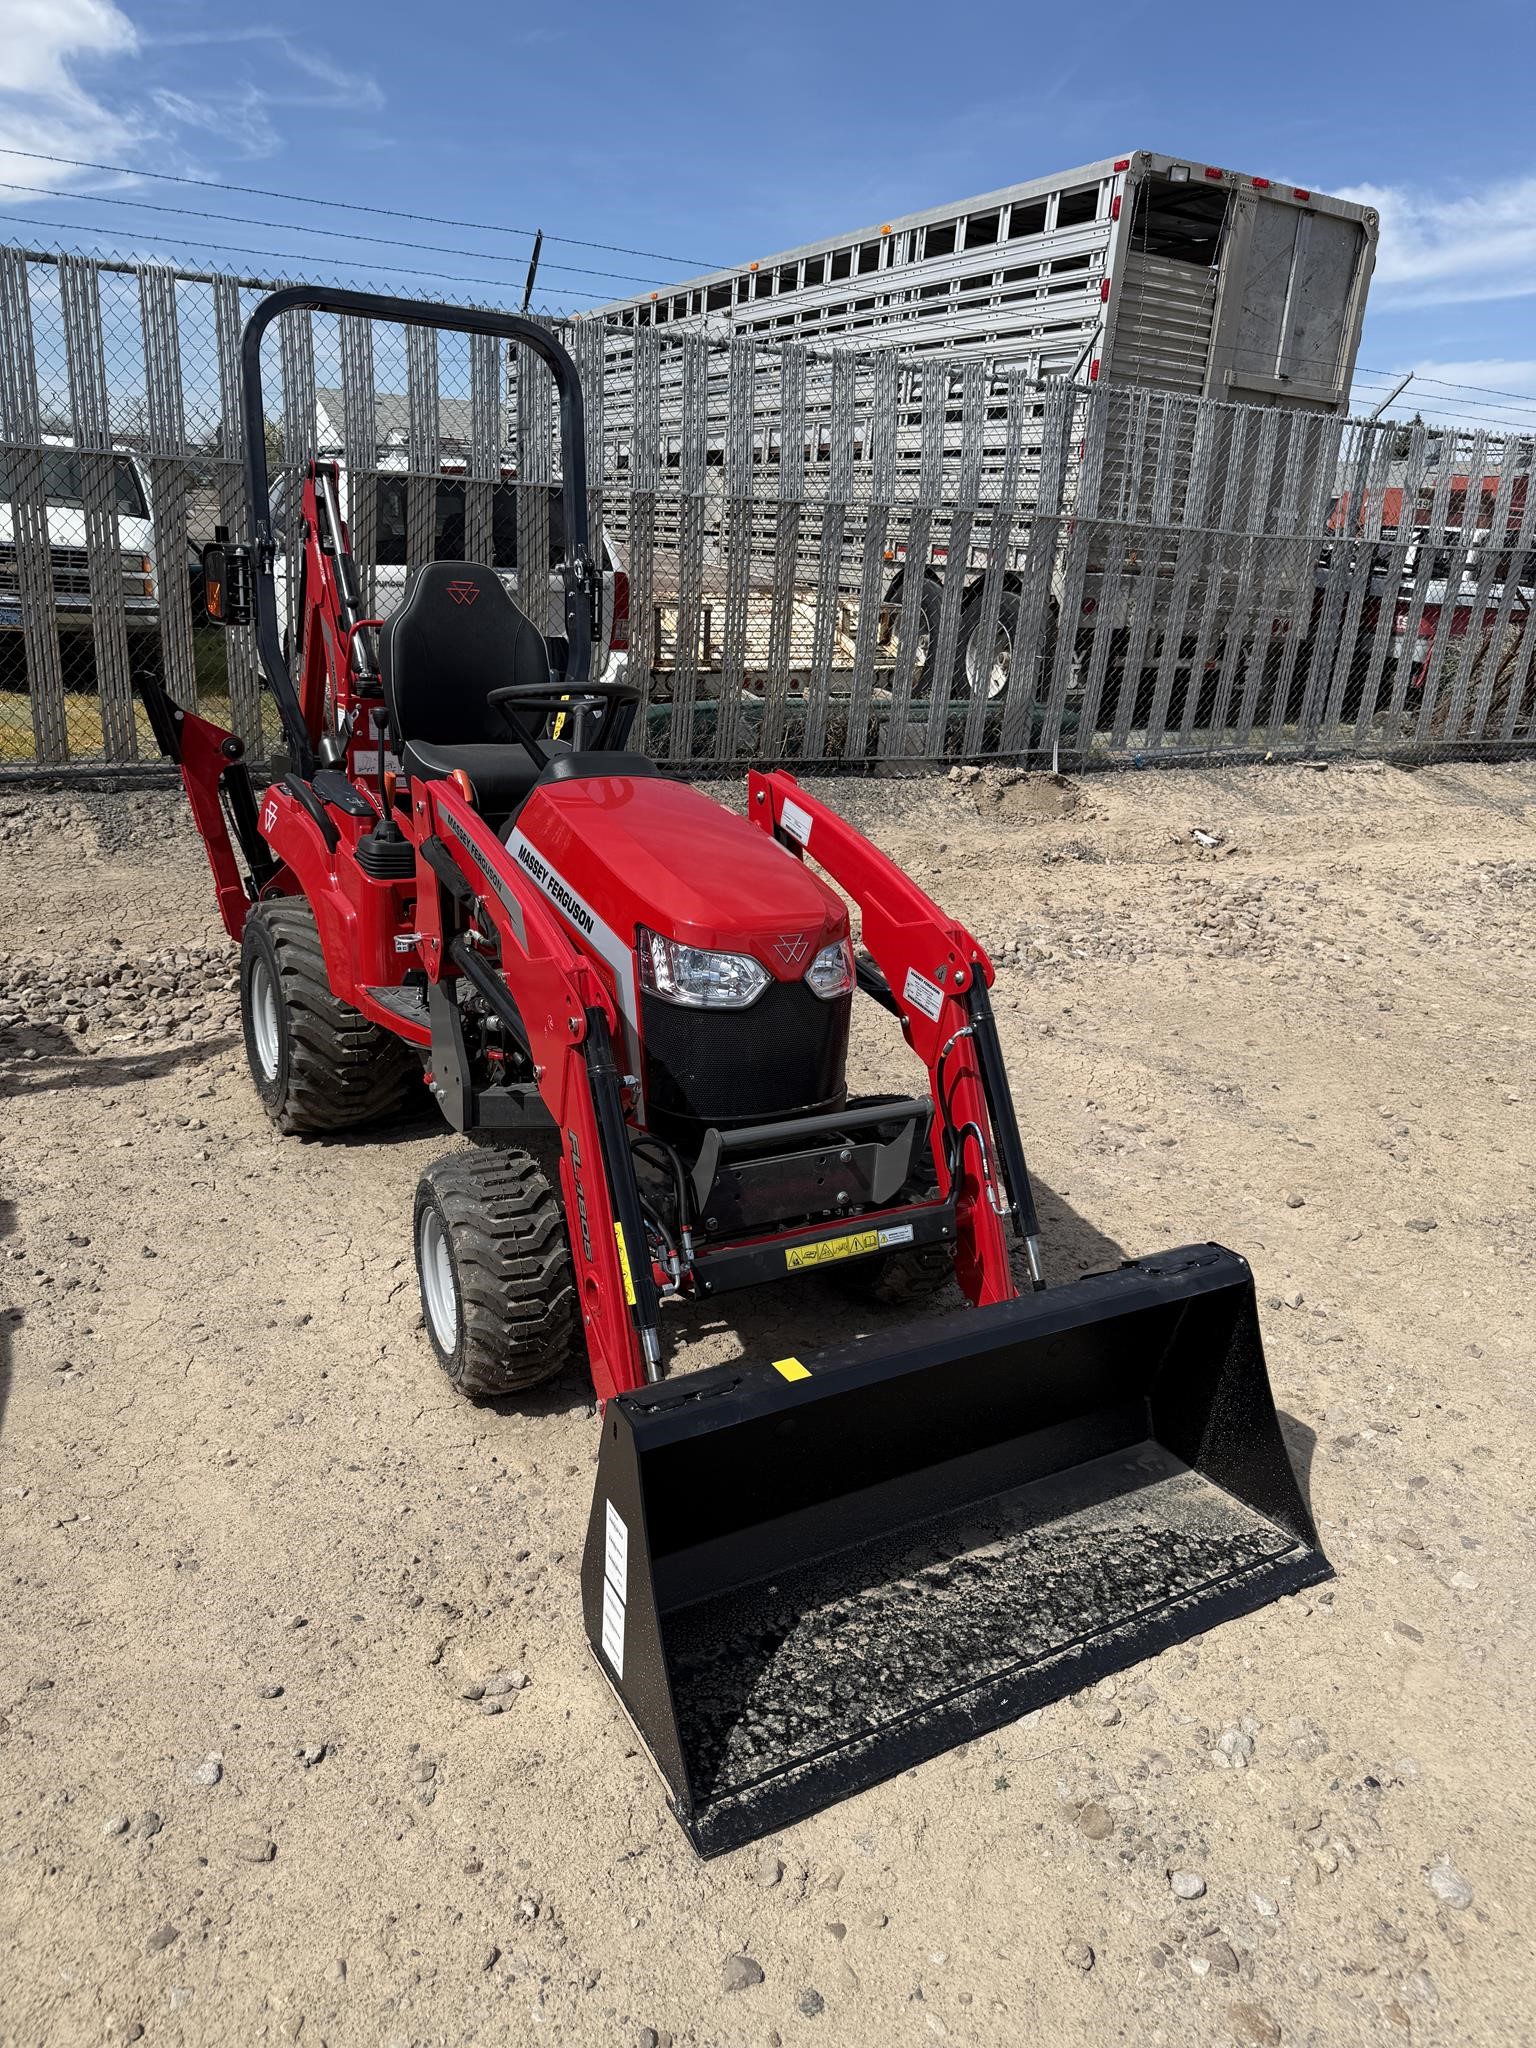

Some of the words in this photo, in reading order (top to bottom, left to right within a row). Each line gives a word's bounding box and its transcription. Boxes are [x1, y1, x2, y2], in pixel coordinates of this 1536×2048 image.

[447, 814, 471, 847] MASSEY
[470, 844, 502, 893] FERGUSON
[517, 844, 549, 884] MASSEY
[547, 879, 595, 934] FERGUSON
